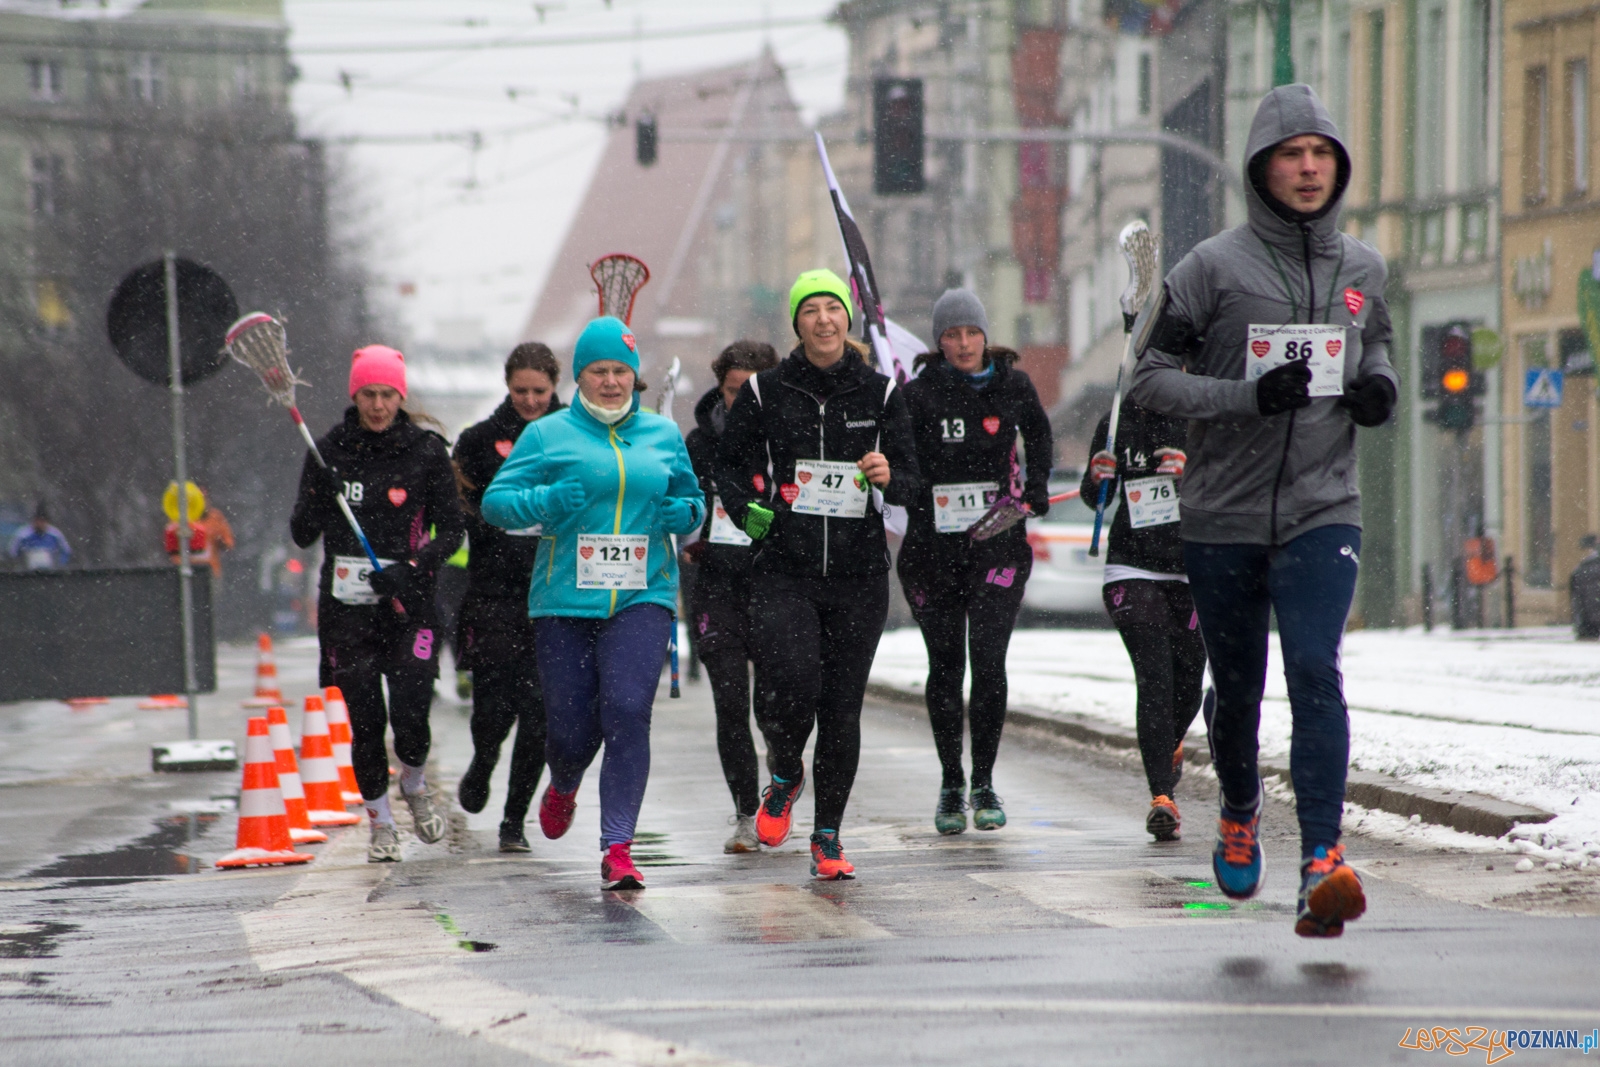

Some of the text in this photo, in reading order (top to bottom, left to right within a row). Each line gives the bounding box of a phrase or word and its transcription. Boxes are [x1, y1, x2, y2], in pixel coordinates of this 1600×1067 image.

[1285, 340, 1312, 360] 86
[941, 419, 965, 438] 13
[1124, 447, 1147, 467] 14
[821, 474, 844, 489] 47
[958, 494, 975, 507] 11
[1150, 485, 1170, 500] 76
[599, 546, 630, 561] 121
[413, 628, 434, 660] 8
